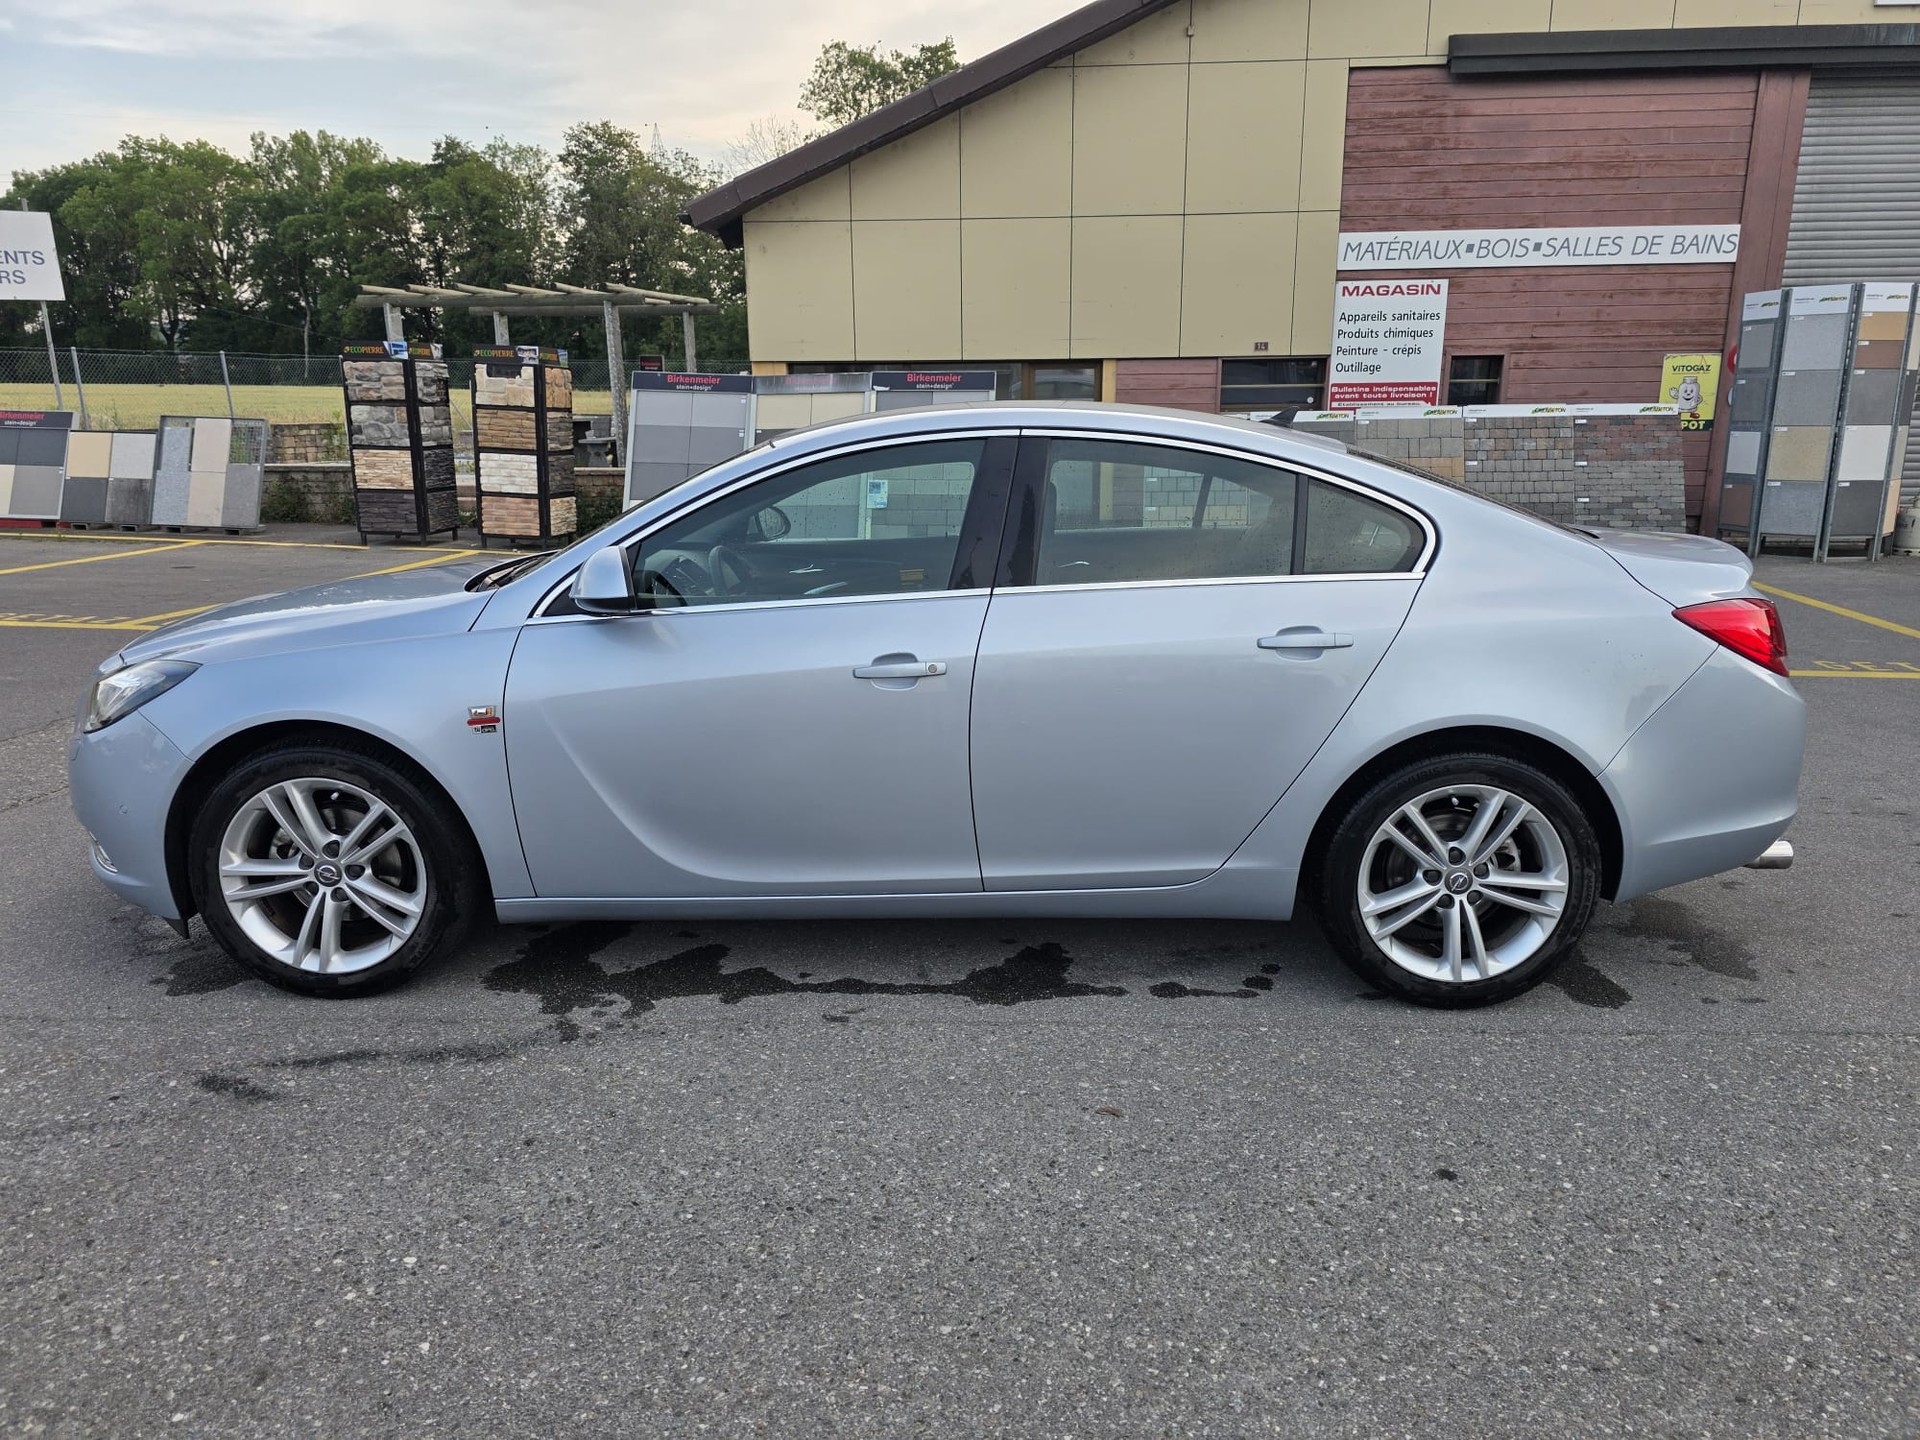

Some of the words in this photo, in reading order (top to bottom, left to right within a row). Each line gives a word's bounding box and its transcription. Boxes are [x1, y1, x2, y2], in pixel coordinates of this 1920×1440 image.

[1343, 236, 1465, 261] MATÉRIAUX
[1476, 238, 1531, 259] BOIS
[1542, 236, 1624, 257] SALLES
[1631, 235, 1664, 255] DE
[1670, 233, 1738, 255] BAINS
[1341, 284, 1441, 297] MAGASIN
[1339, 311, 1387, 325] Appareils
[1391, 310, 1441, 321] sanitaires
[1337, 328, 1379, 339] Produits
[1383, 327, 1434, 340] chimiques
[1336, 345, 1378, 356] Peinture
[1392, 344, 1422, 357] crépis
[1335, 362, 1382, 375] Outillage
[667, 374, 720, 384] Birkenmeier
[906, 373, 962, 382] Birkenmeier
[1373, 385, 1437, 393] indispensables
